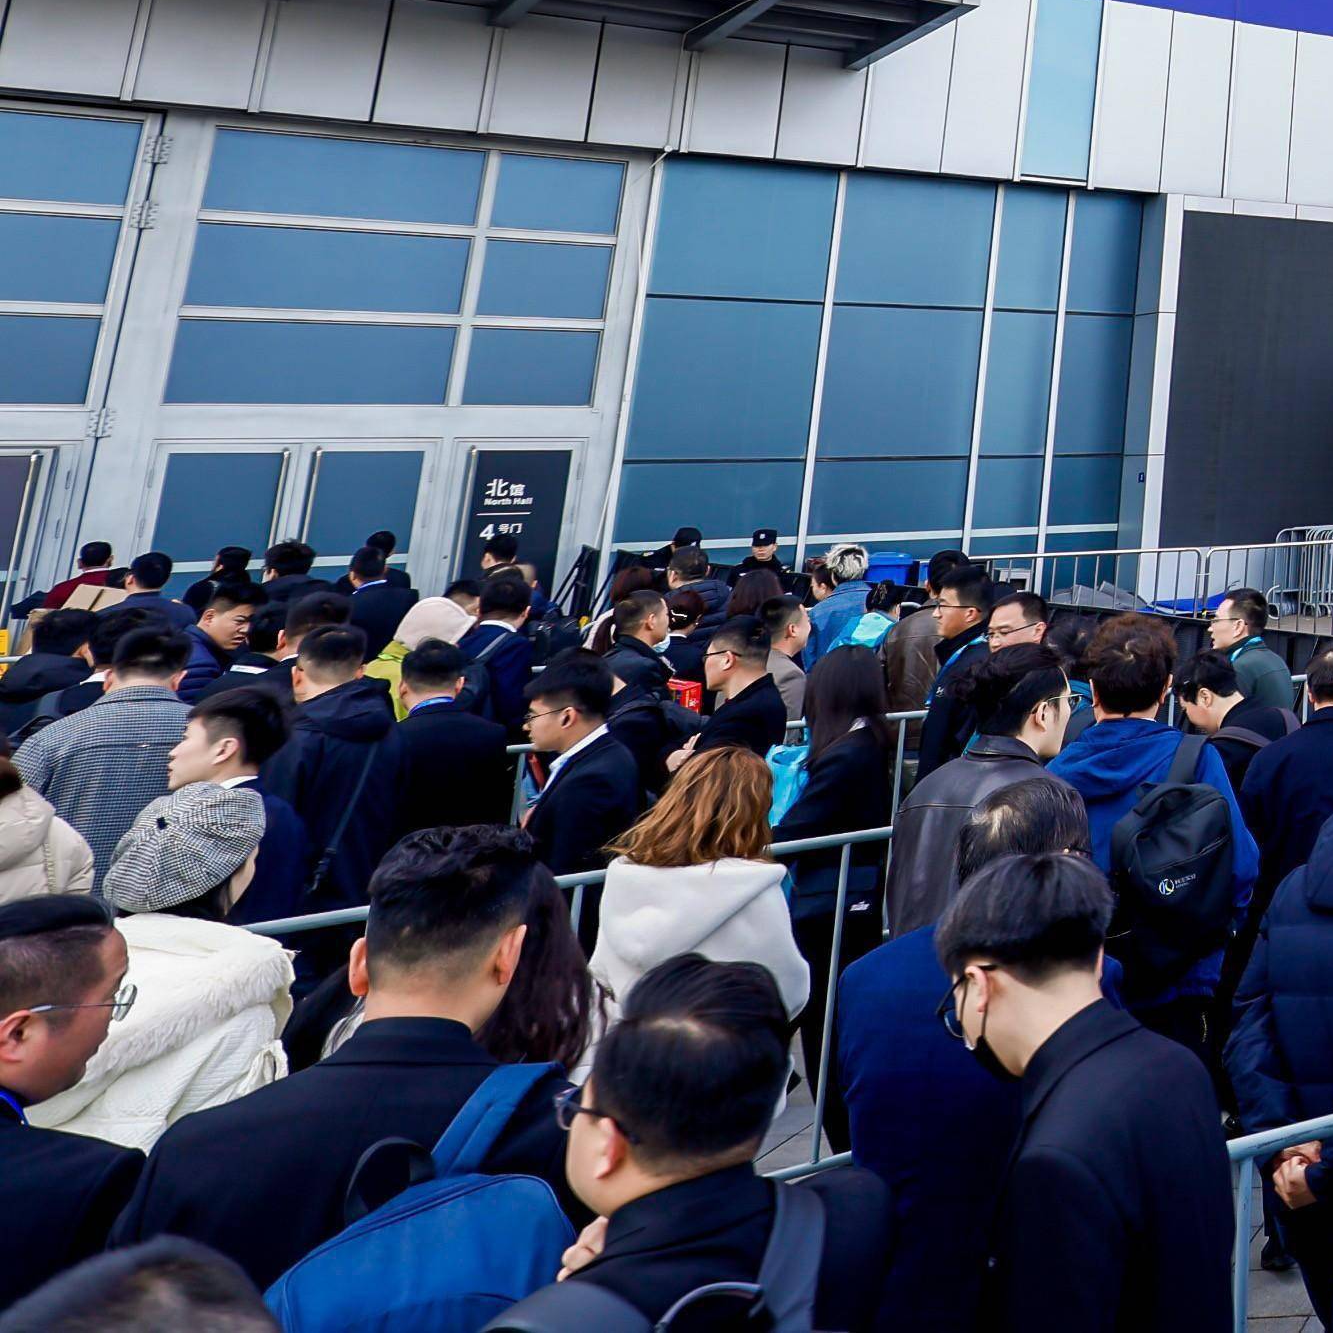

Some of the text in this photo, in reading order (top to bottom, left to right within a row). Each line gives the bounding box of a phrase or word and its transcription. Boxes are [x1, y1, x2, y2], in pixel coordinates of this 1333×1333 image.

[485, 478, 526, 497] 北馆
[484, 497, 533, 506] North Hall
